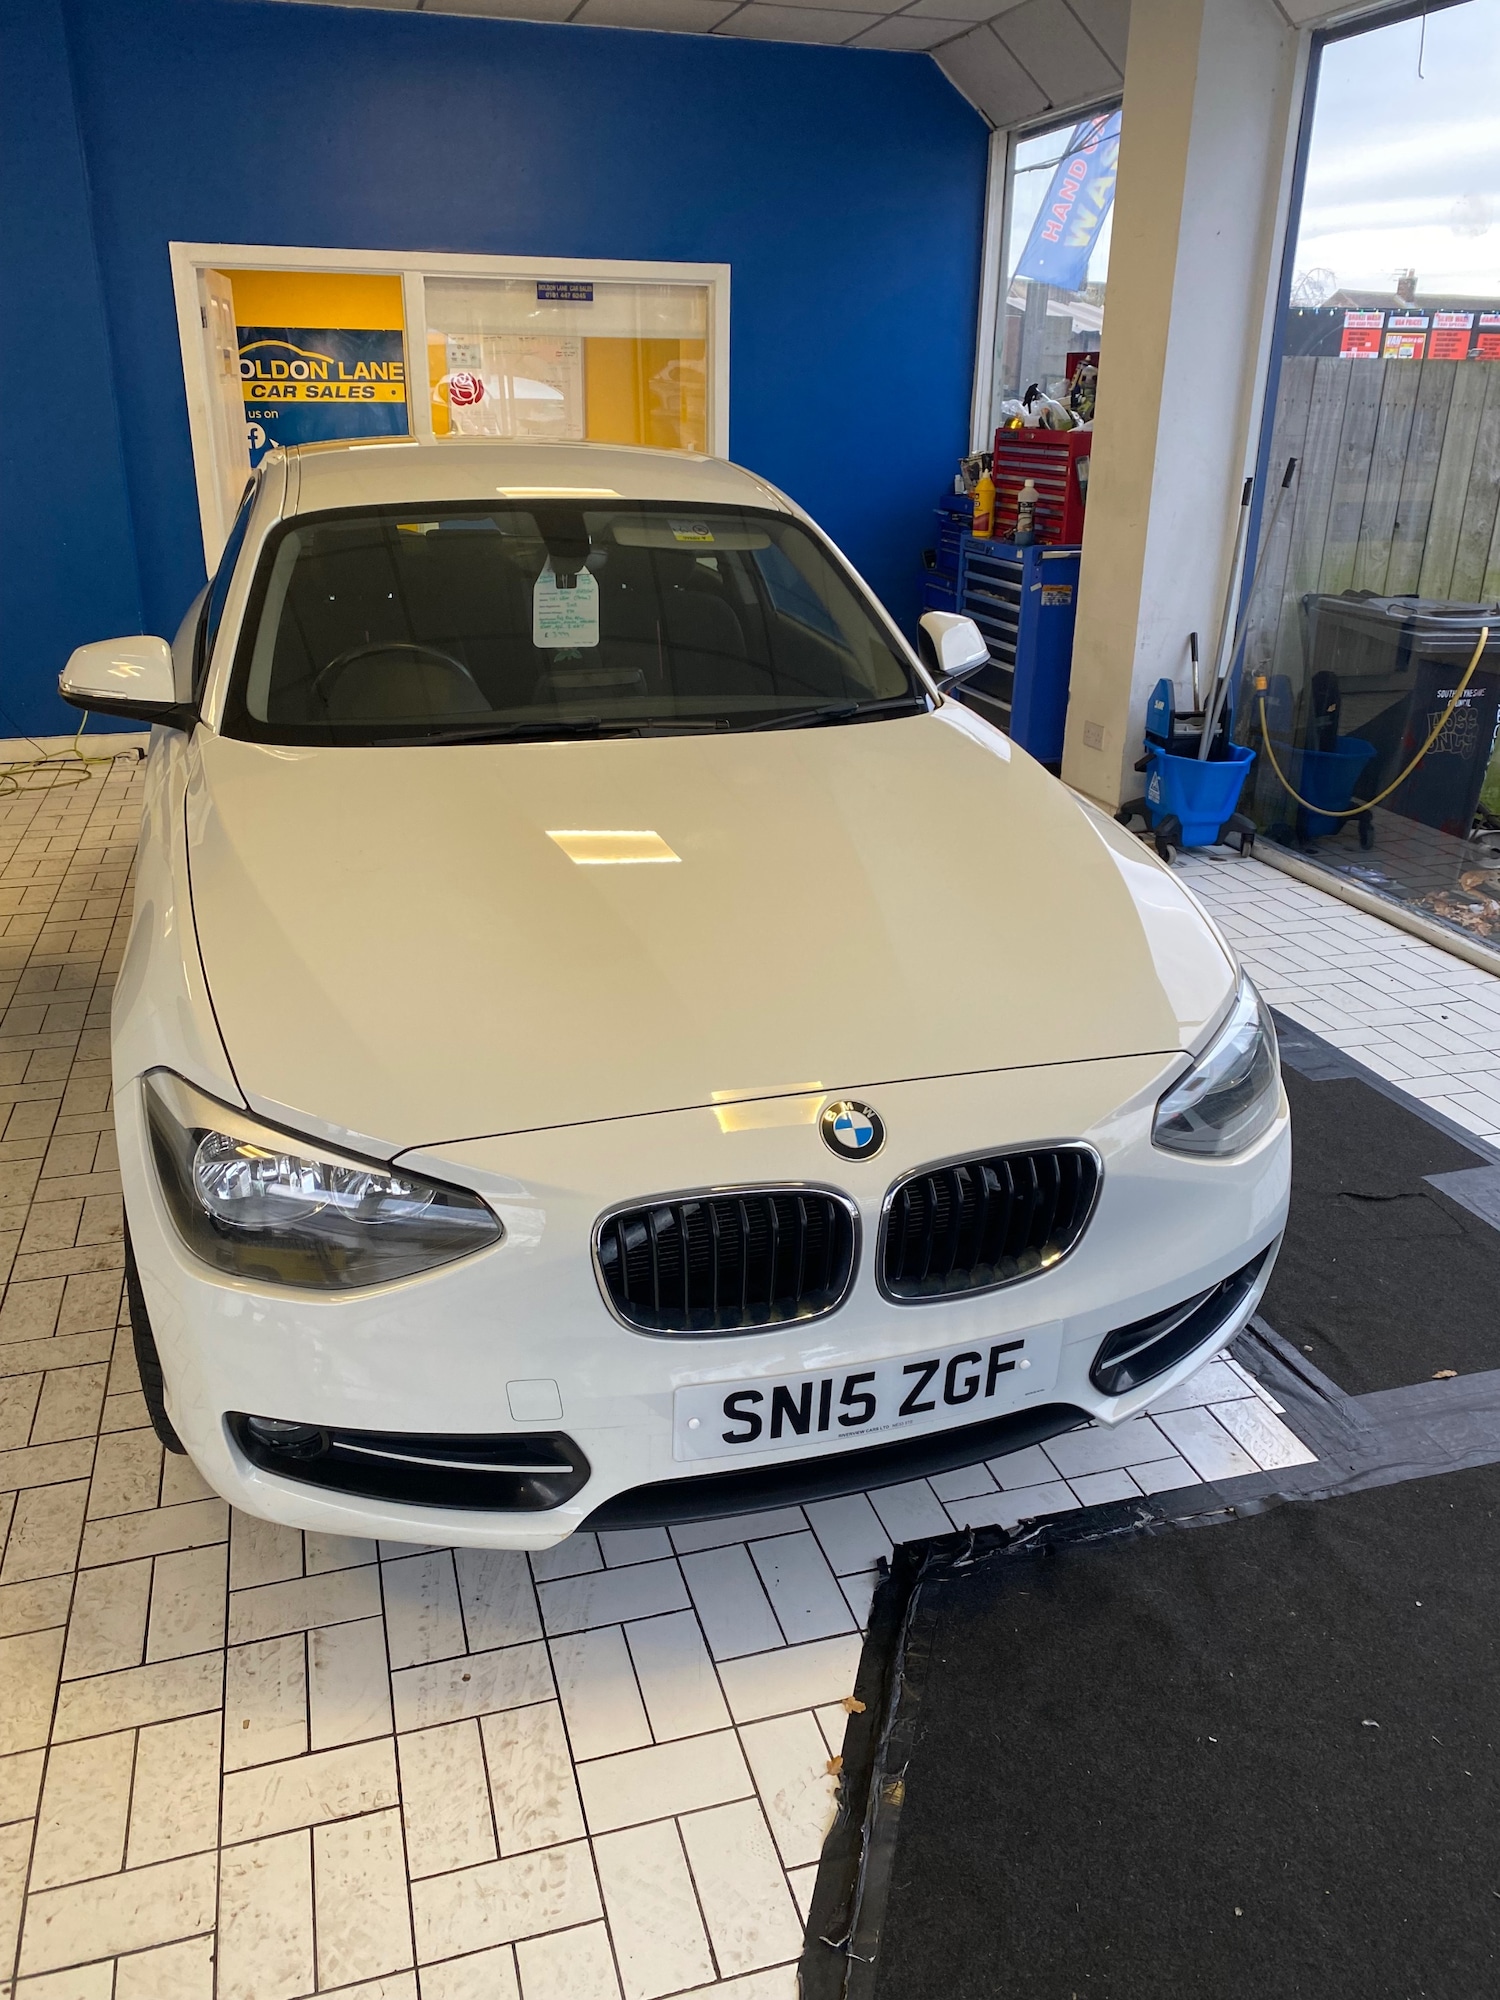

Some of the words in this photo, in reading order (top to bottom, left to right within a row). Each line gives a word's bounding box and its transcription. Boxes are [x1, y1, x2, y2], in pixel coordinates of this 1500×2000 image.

[1041, 158, 1088, 242] HAND
[1387, 336, 1402, 347] VAN
[338, 361, 404, 380] LANE
[251, 385, 297, 398] CAR
[305, 385, 375, 399] SALES
[248, 410, 261, 419] us
[264, 410, 279, 419] on
[825, 1101, 875, 1122] BMW
[722, 1371, 877, 1444] SN15
[898, 1339, 1025, 1417] ZGF
[838, 1430, 865, 1438] RIVERVIEW
